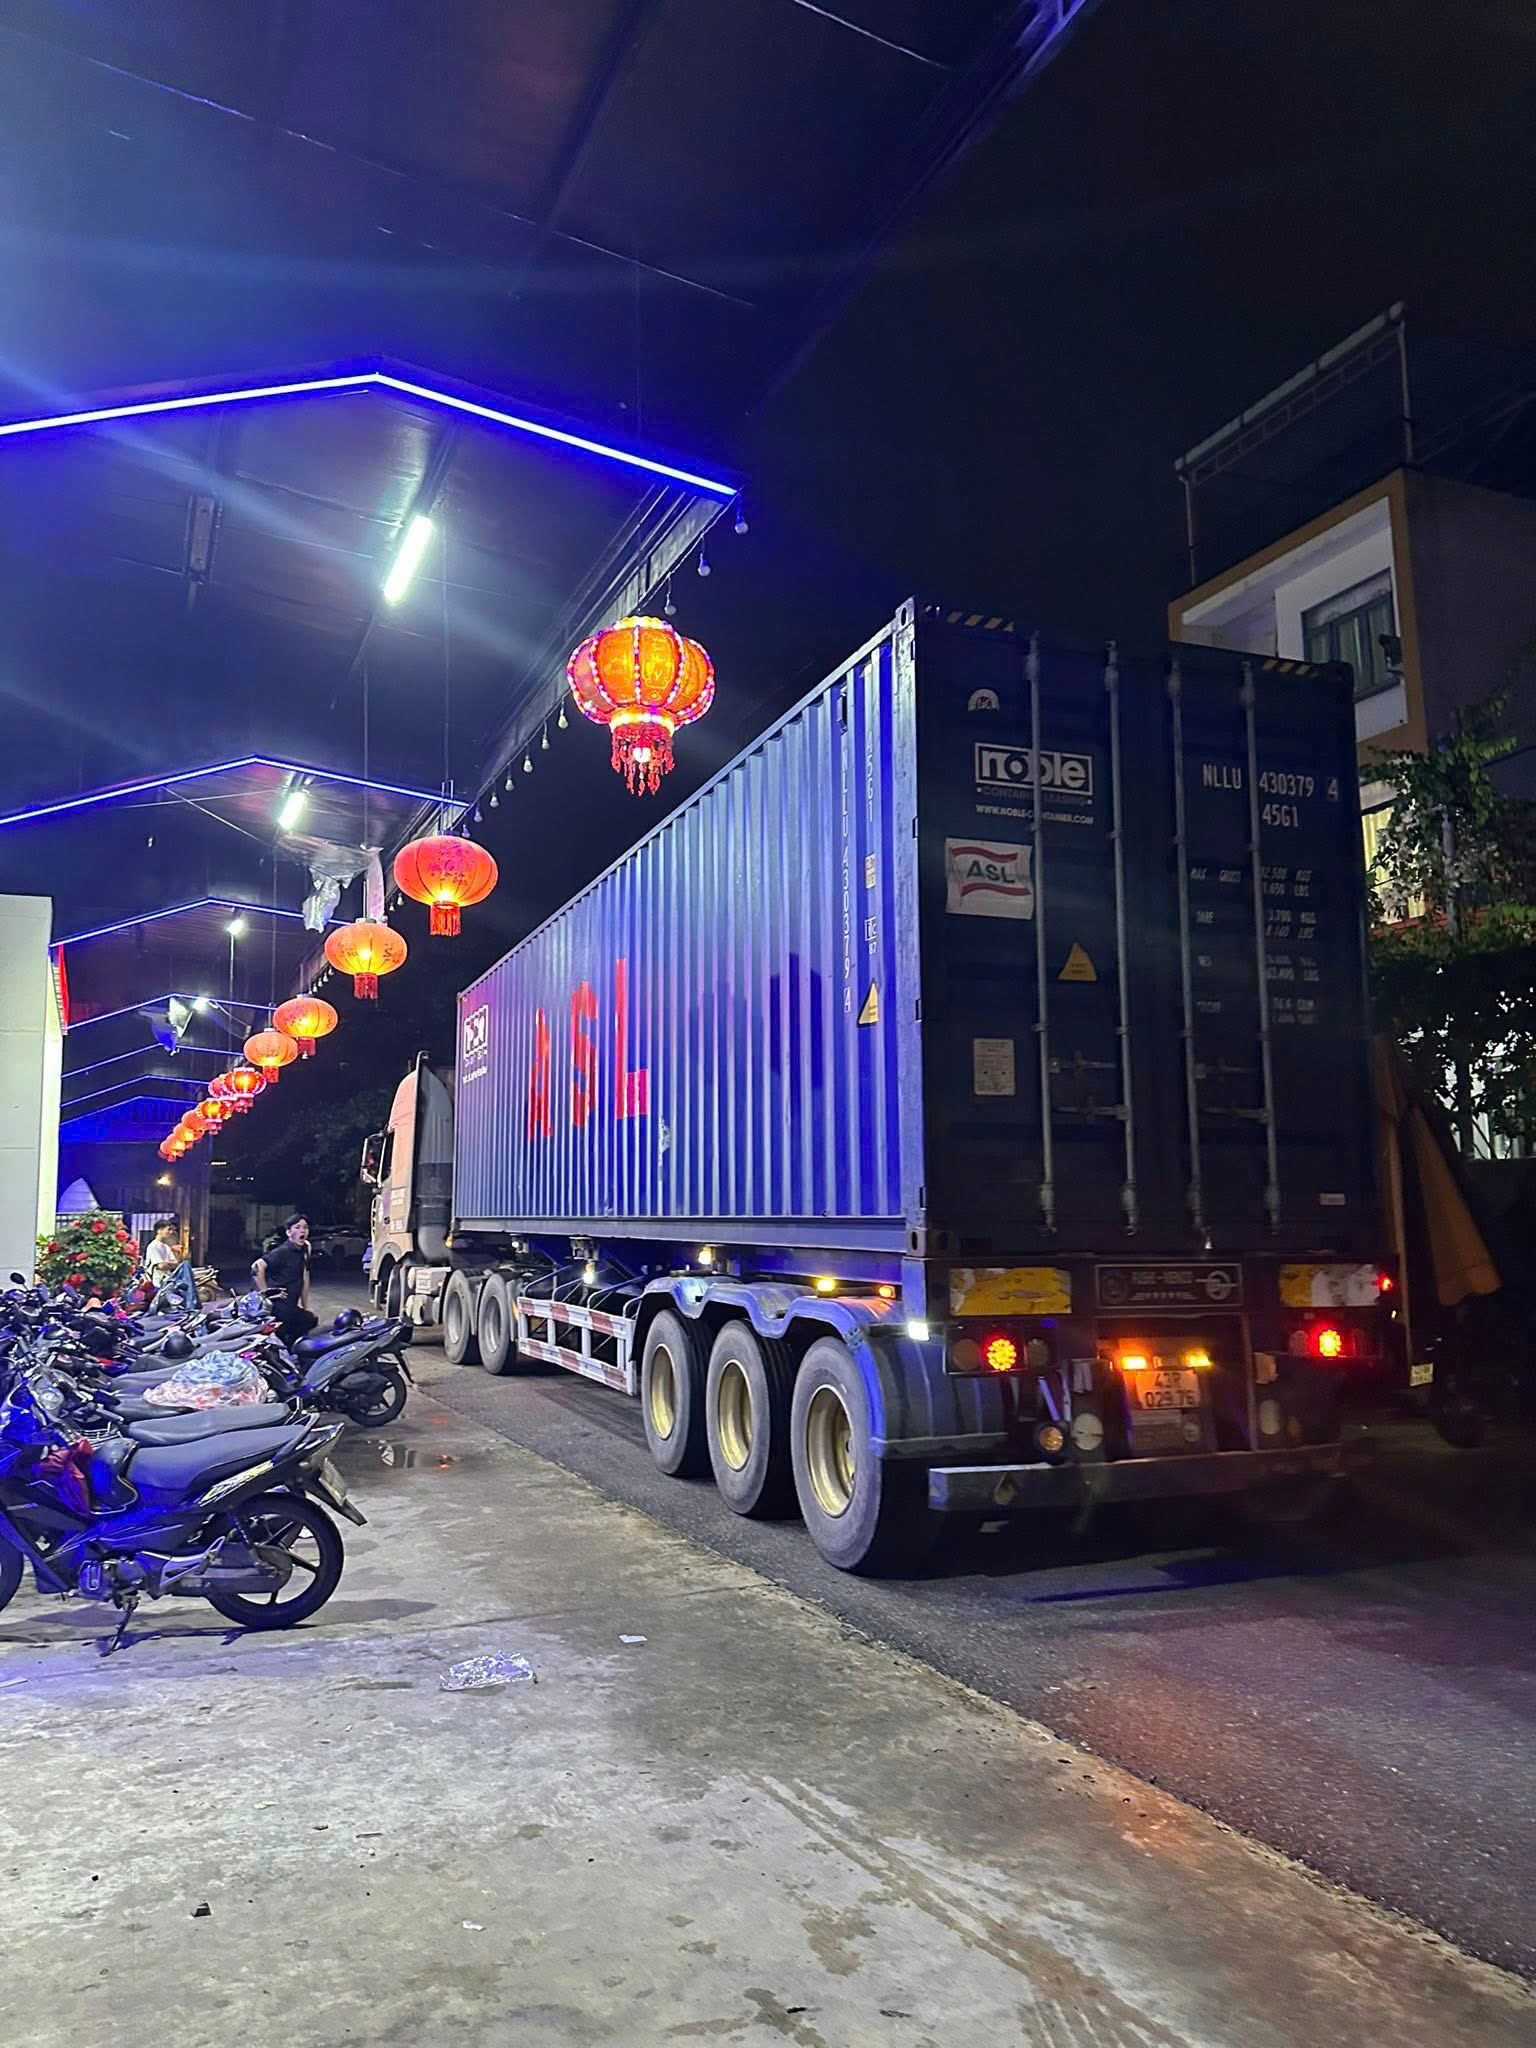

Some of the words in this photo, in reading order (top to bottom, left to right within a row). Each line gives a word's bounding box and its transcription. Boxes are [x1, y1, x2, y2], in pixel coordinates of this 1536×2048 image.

[1202, 763, 1242, 789] NLLU
[1258, 771, 1315, 797] 430379
[1261, 803, 1299, 828] 45G1
[966, 859, 1016, 884] ASL
[527, 956, 648, 1141] ASL
